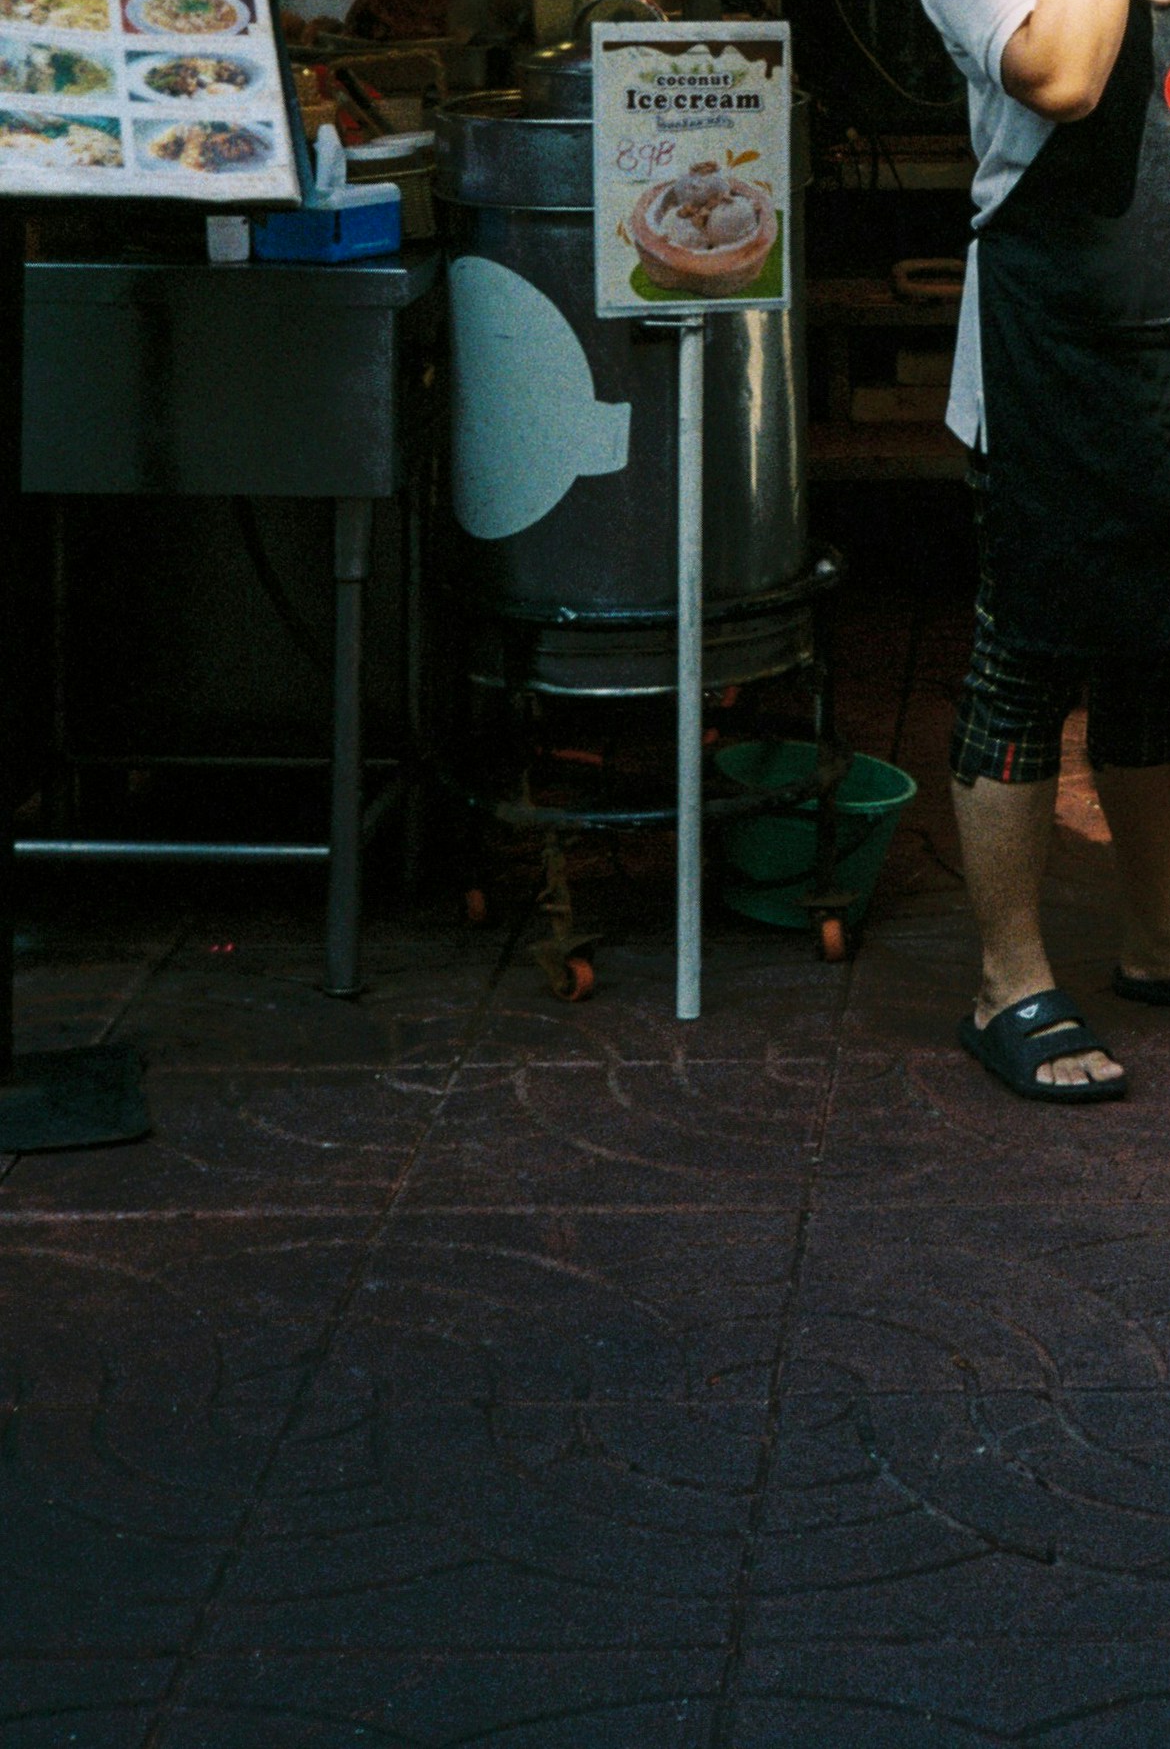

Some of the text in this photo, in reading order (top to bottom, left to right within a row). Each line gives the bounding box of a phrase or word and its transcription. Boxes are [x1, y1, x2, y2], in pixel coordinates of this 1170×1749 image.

[656, 74, 731, 87] coconut
[625, 88, 762, 110] Ice cream
